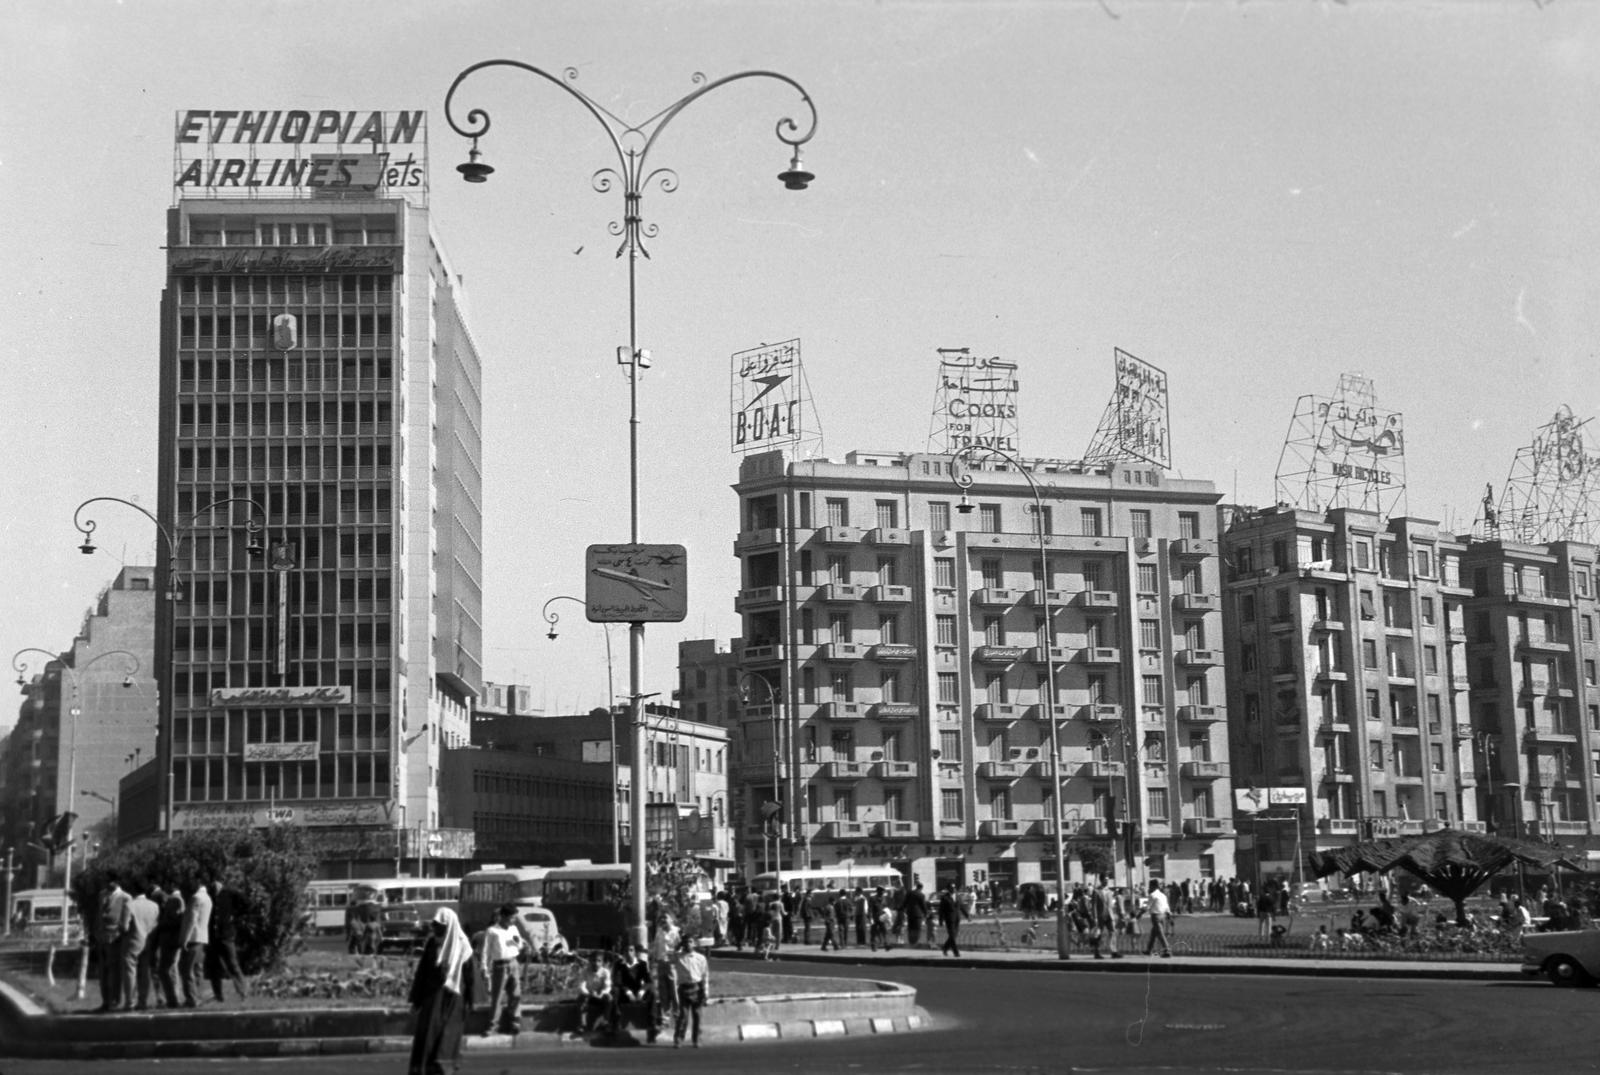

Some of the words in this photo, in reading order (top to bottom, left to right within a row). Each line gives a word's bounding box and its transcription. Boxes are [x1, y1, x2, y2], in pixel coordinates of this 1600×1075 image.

[177, 110, 424, 144] ETHIOPIAN
[174, 158, 359, 187] AIRLINES
[362, 152, 424, 191] Jets
[951, 435, 1017, 452] TRAVEL
[267, 808, 293, 819] TWA
